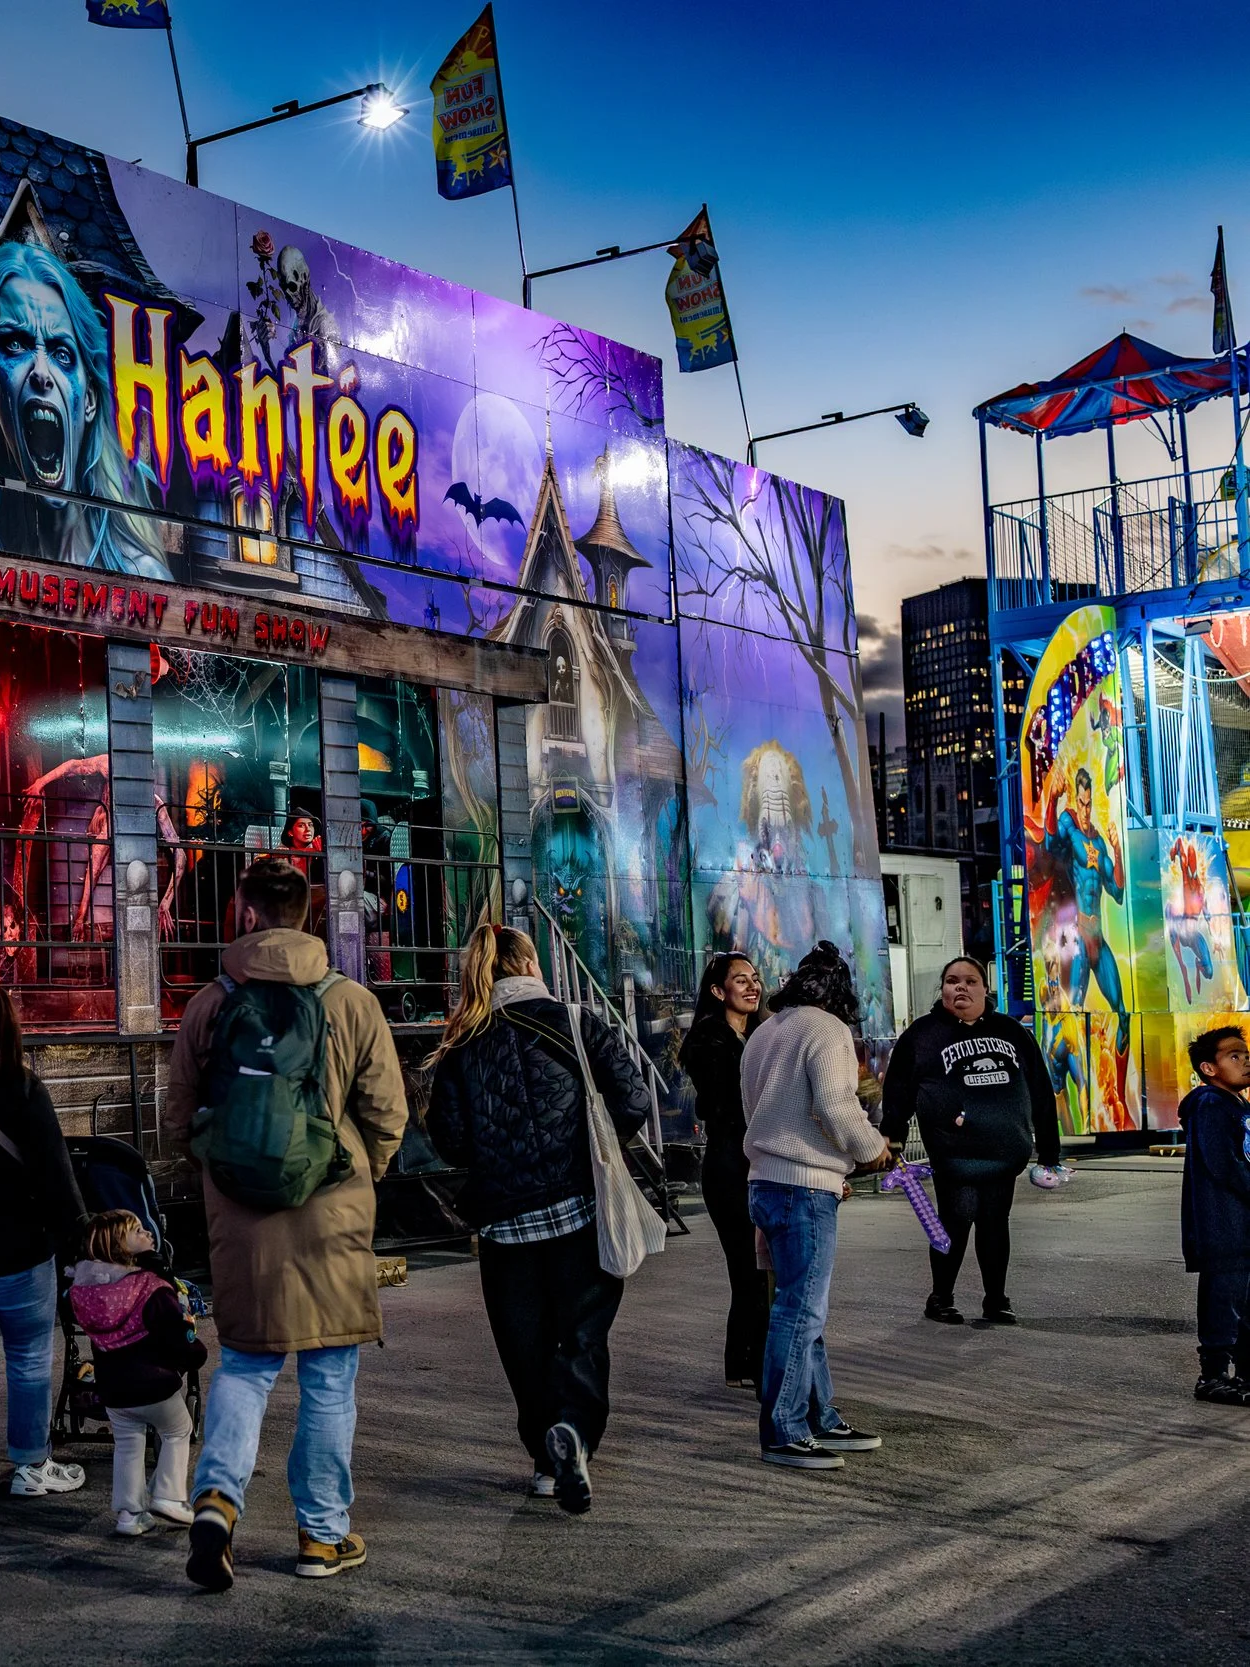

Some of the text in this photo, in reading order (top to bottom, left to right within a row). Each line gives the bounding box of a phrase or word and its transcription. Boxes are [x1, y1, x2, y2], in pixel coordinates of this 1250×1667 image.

[103, 290, 419, 535] Hantée
[184, 600, 239, 642] FUN
[254, 611, 332, 652] SHOW
[967, 1072, 1007, 1085] LIFESTYLE
